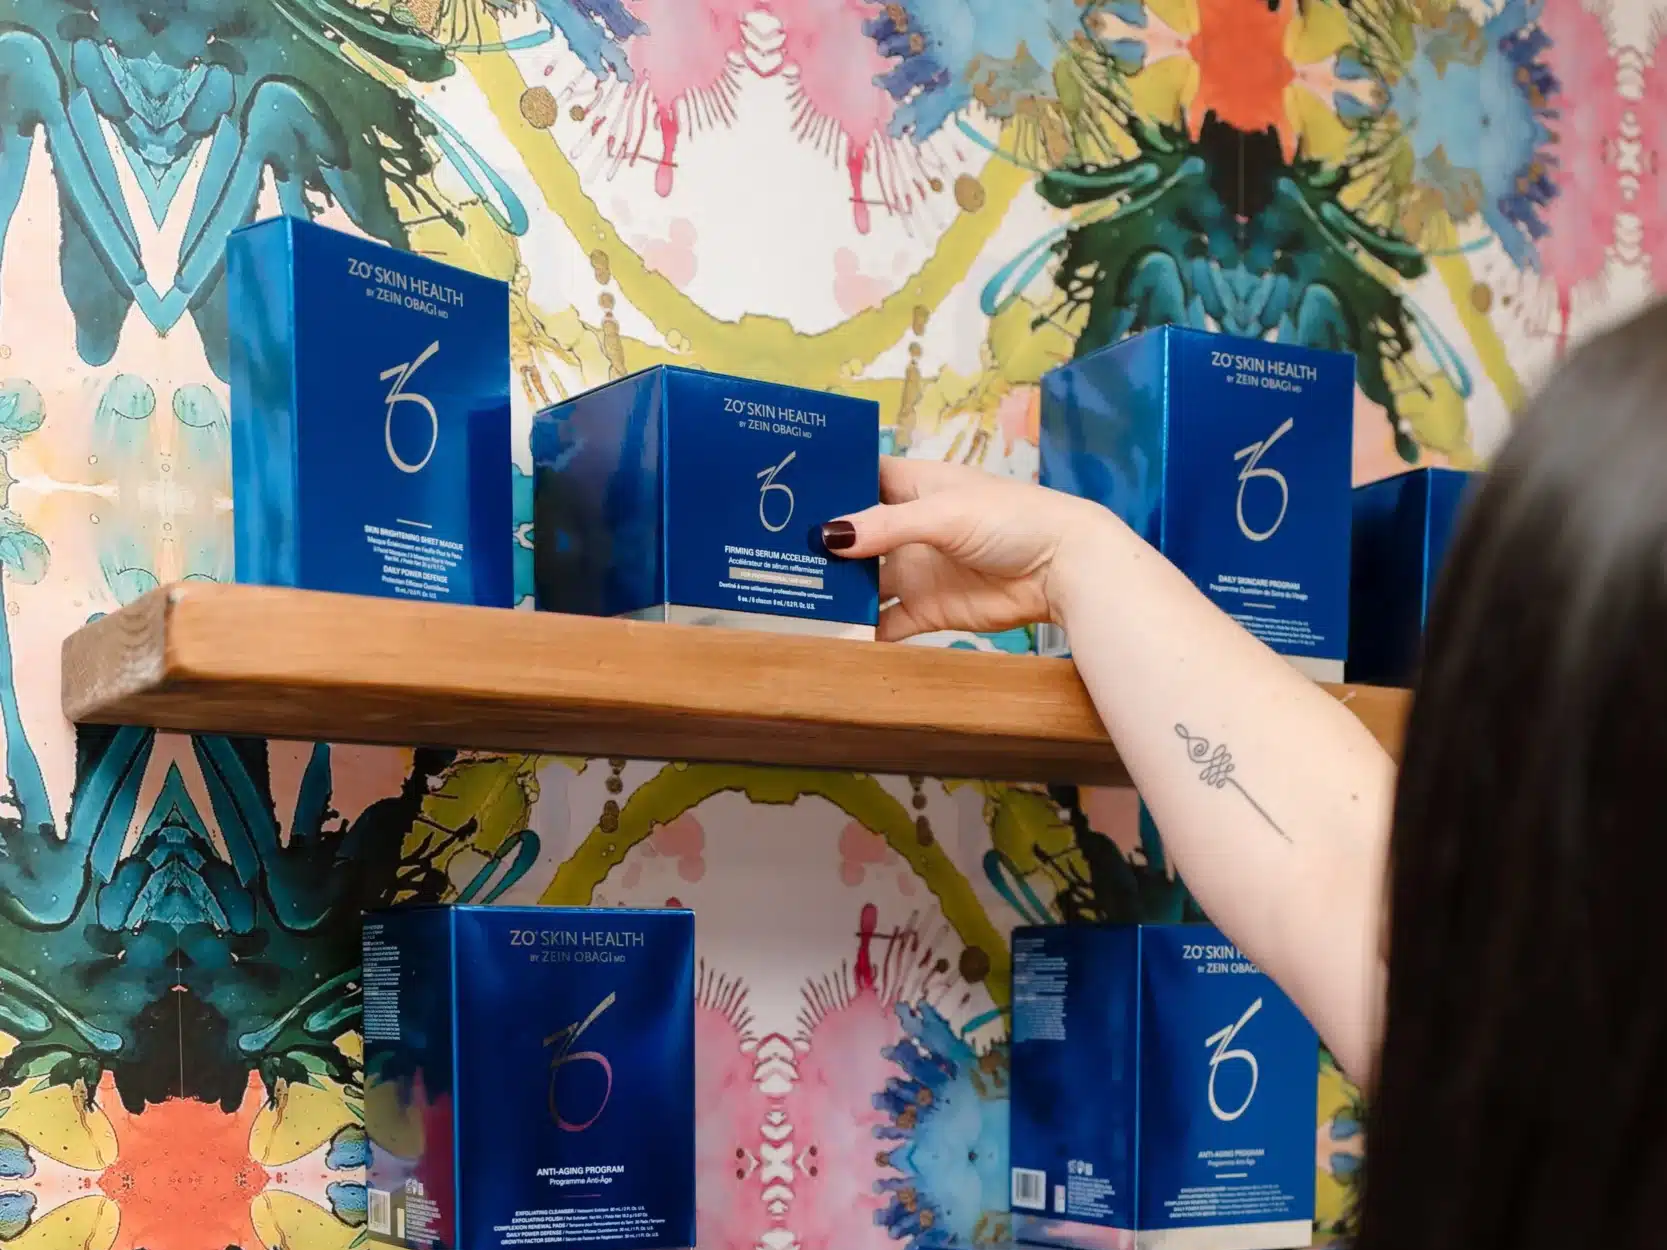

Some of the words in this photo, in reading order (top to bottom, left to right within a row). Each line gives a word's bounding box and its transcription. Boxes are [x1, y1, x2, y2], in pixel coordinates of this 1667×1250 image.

[374, 267, 407, 290] SKIN
[411, 277, 463, 307] HEALTH
[376, 287, 400, 305] ZEIN
[404, 296, 436, 315] OBAGI
[1235, 355, 1264, 373] SKIN
[1268, 360, 1316, 381] HEALTH
[1236, 373, 1258, 386] ZEIN
[1261, 377, 1291, 392] OBAGI
[747, 402, 775, 419] SKIN
[779, 407, 826, 427] HEALTH
[748, 420, 770, 432] ZEIN
[772, 424, 801, 437] OBAGI
[725, 545, 753, 556] FIRMING
[755, 549, 779, 560] SERUM
[781, 553, 827, 565] ACCELERATED
[383, 565, 400, 575] DAILY
[401, 568, 422, 579] POWER
[1218, 575, 1236, 584] DAILY
[541, 931, 577, 945] SKIN
[582, 932, 644, 946] HEALTH
[542, 951, 570, 962] ZEIN
[574, 951, 612, 962] OBAGI
[1206, 945, 1234, 960] SKIN
[1207, 963, 1228, 973] ZEIN
[536, 1167, 584, 1176] ANTI-AGING
[585, 1165, 624, 1173] PROGRAM
[549, 1178, 585, 1186] Programme
